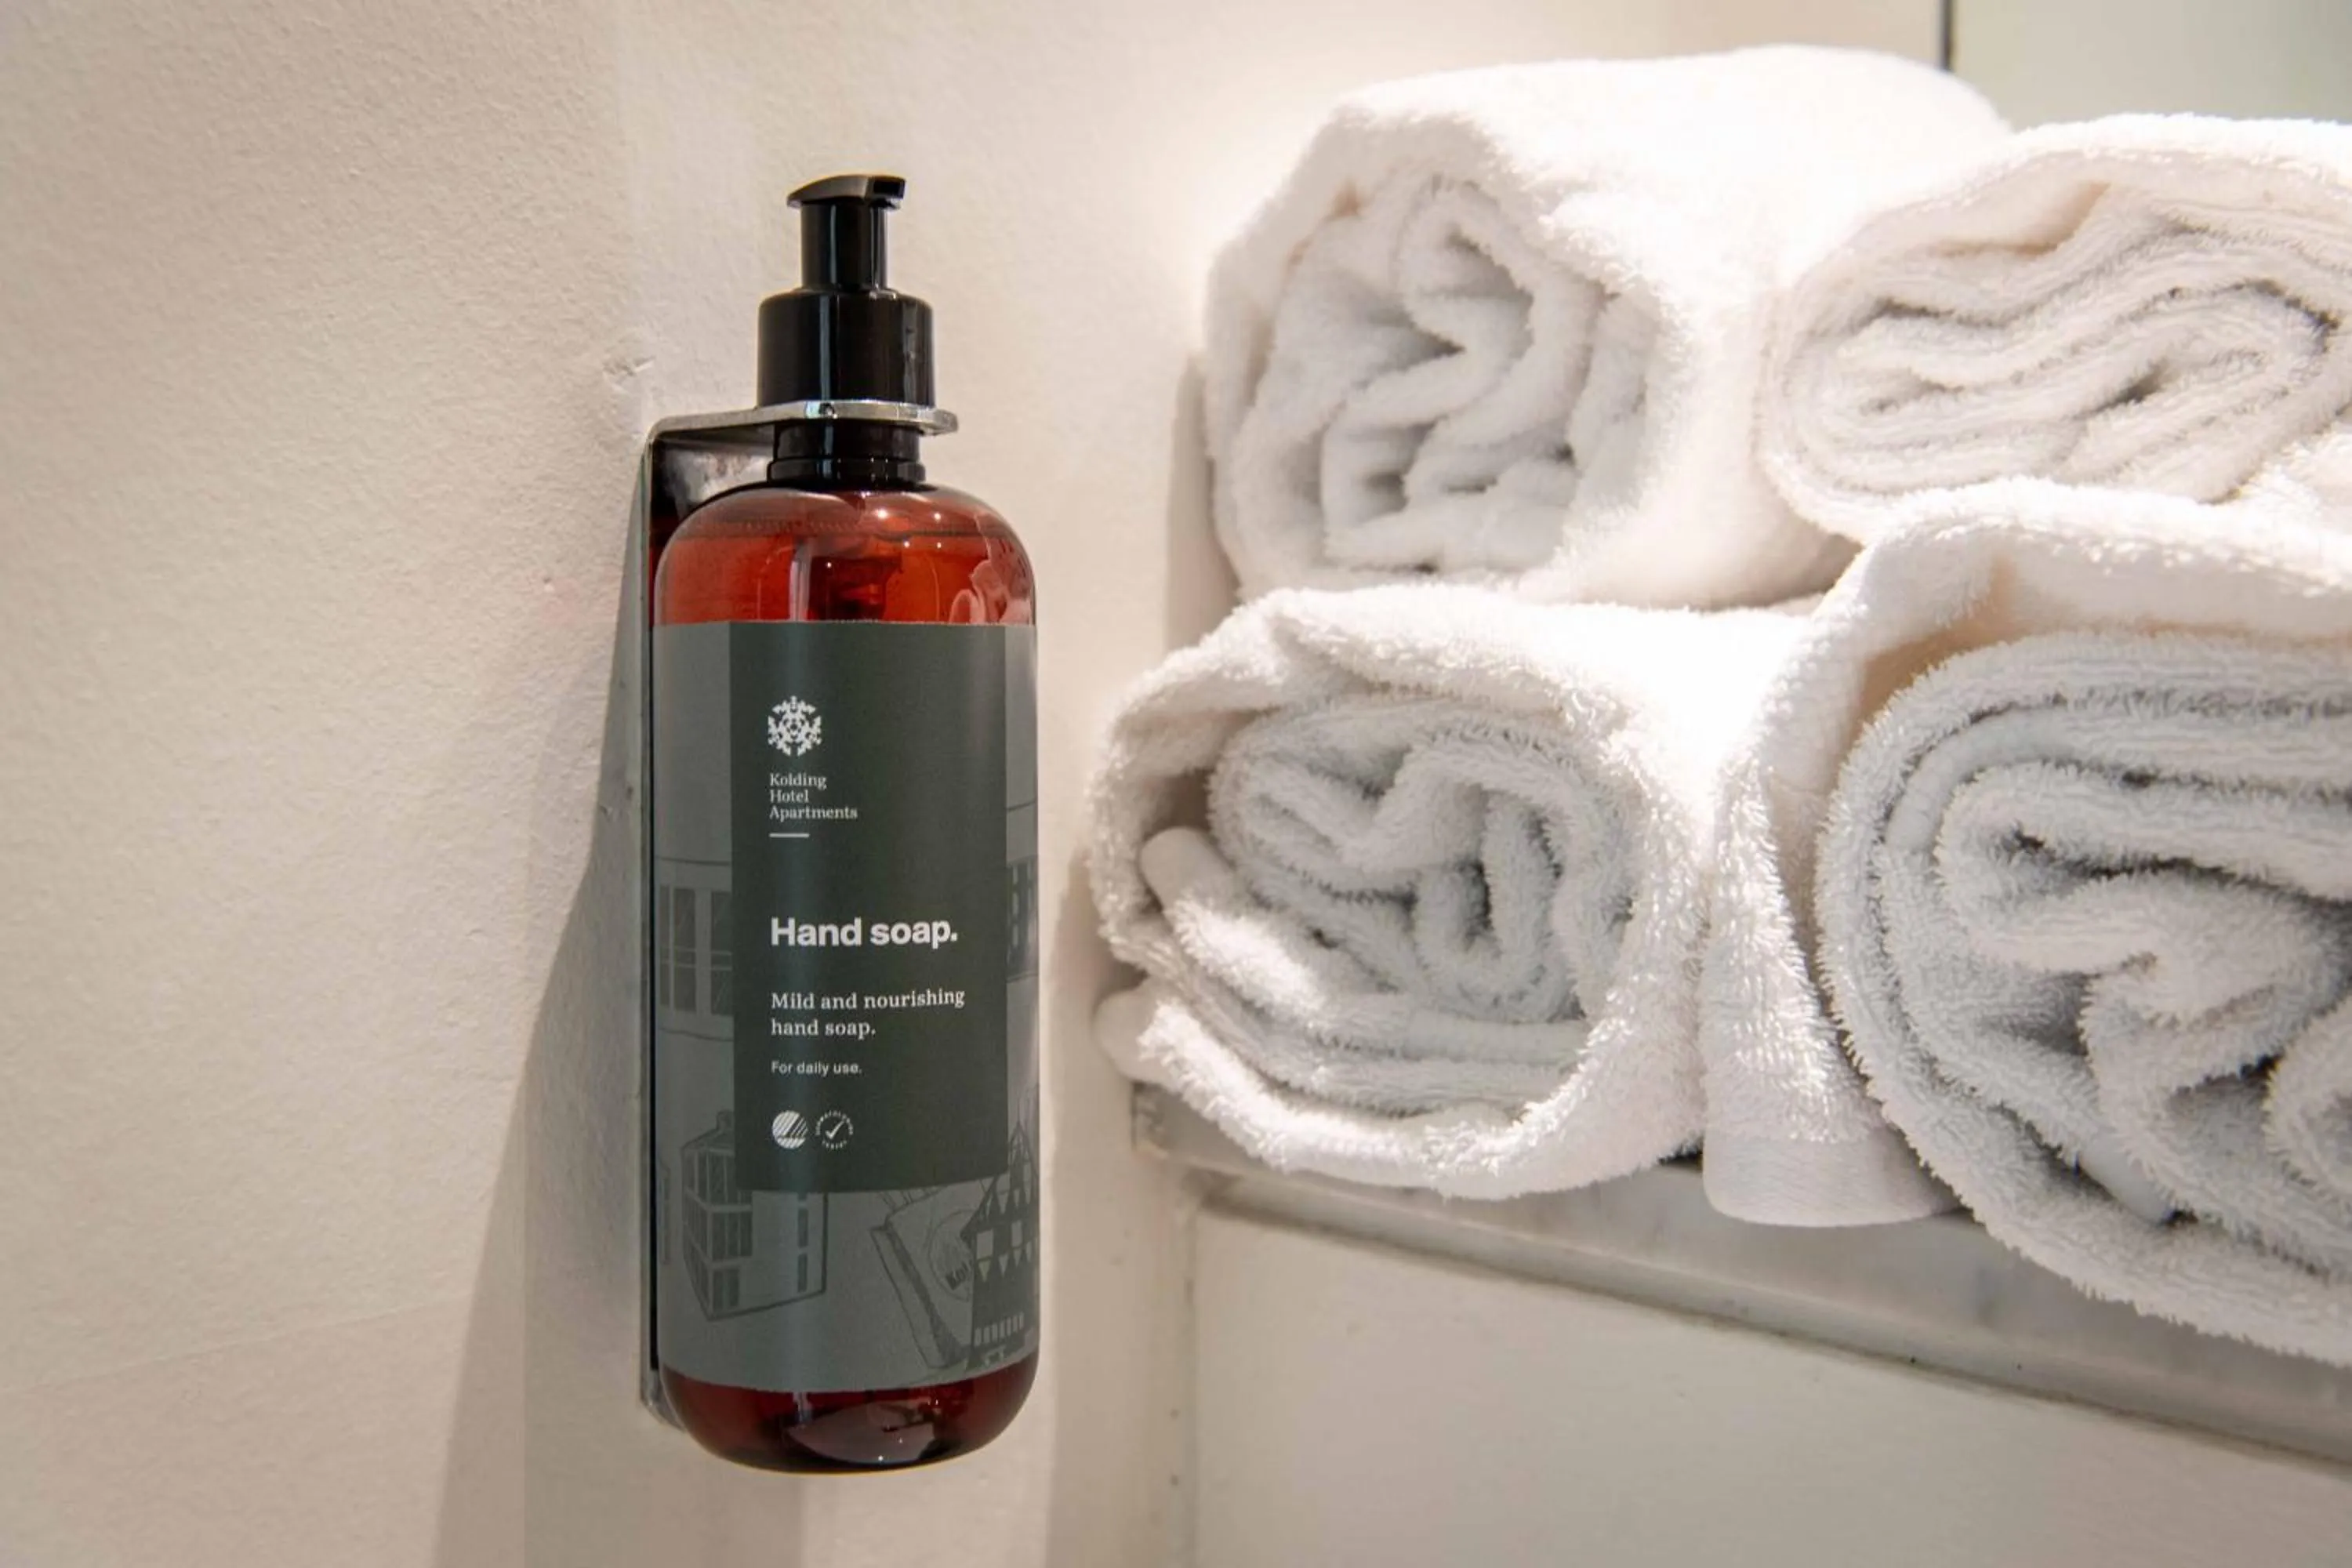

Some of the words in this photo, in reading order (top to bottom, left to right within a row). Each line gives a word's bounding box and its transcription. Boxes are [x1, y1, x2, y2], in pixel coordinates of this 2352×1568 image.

[770, 773, 827, 789] Kolding
[770, 789, 808, 804] Hotel
[769, 805, 858, 822] Apartments
[771, 917, 862, 947] Hand
[870, 920, 958, 949] soap.
[771, 992, 815, 1010] Mild
[820, 993, 858, 1010] and
[864, 988, 965, 1009] nourishing
[771, 1018, 819, 1036] hand
[824, 1021, 877, 1040] soap.
[771, 1061, 794, 1075] For
[797, 1062, 829, 1078] daily
[833, 1063, 862, 1076] use.
